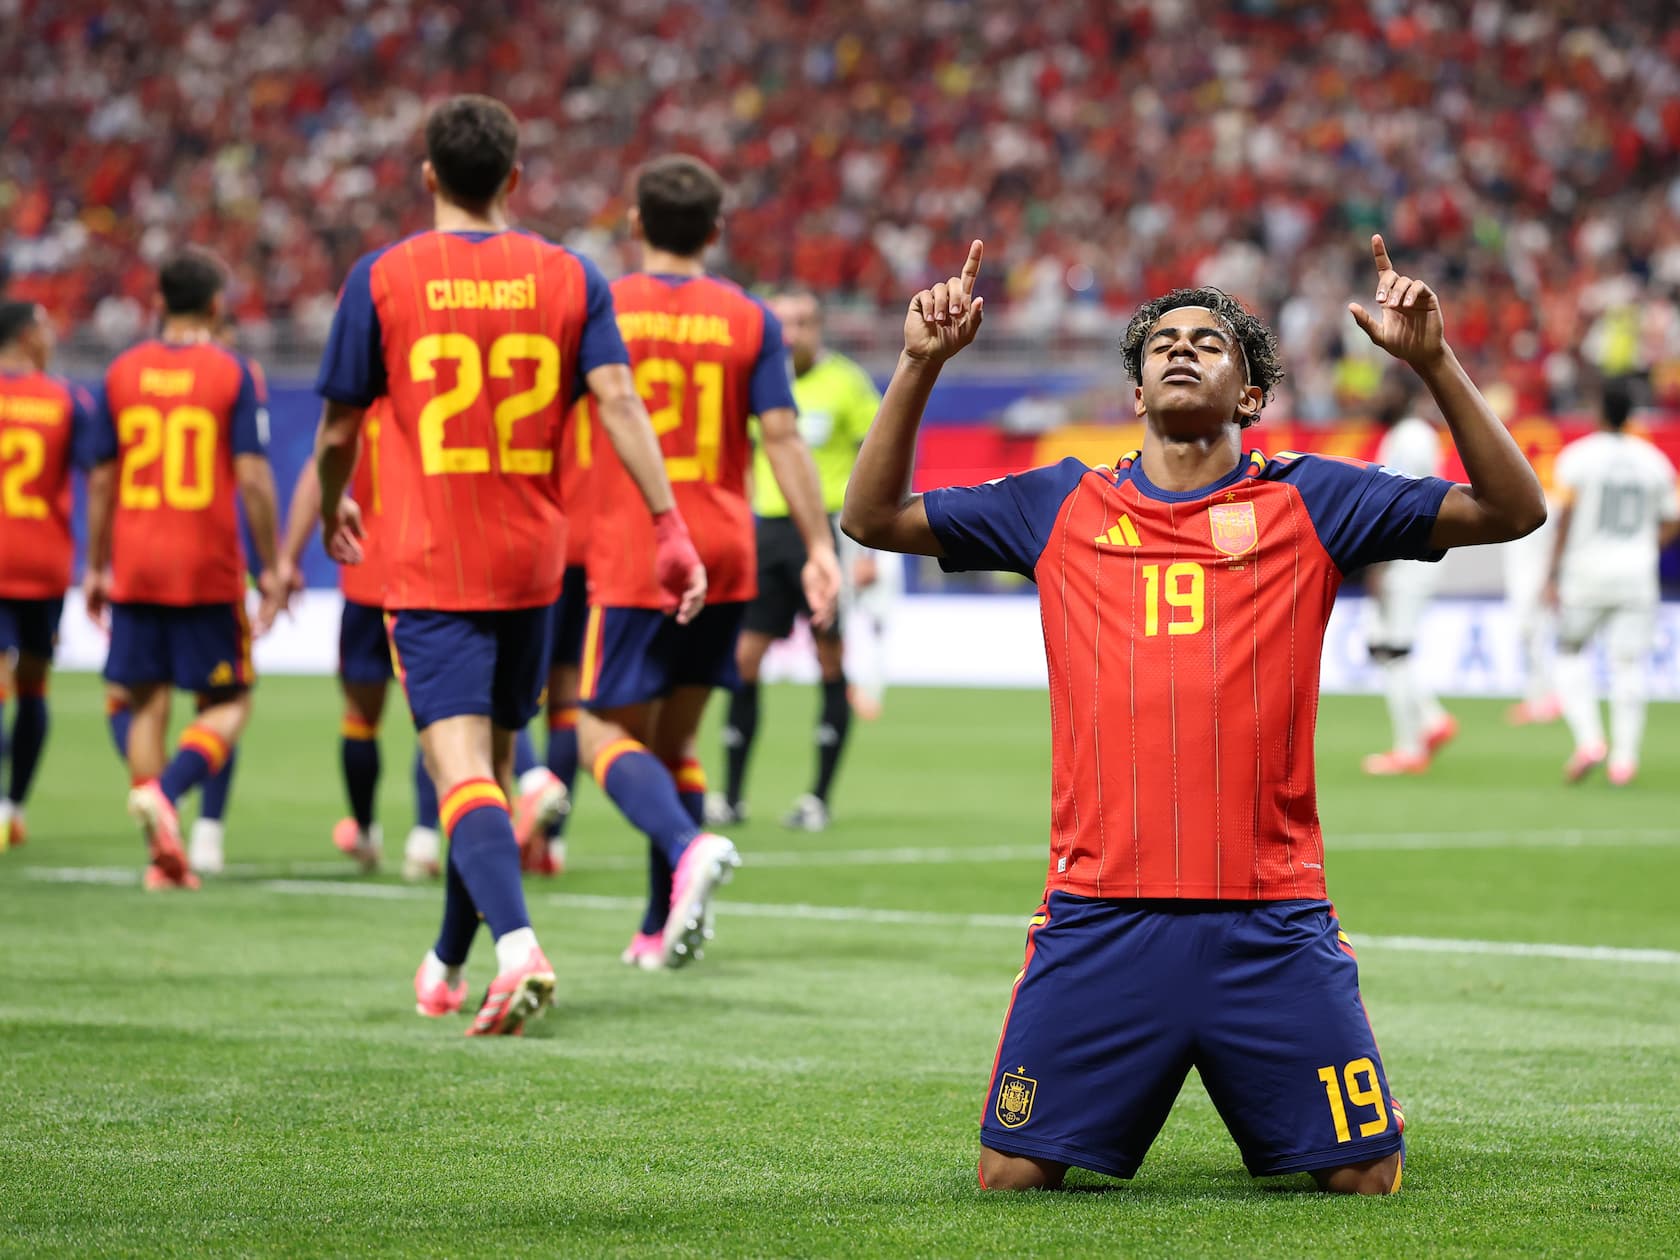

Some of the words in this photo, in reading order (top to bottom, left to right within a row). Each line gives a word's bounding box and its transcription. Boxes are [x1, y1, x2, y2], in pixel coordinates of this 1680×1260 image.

[426, 273, 536, 310] CUBARSÍ
[408, 333, 561, 475] 22
[634, 357, 723, 487] 21
[118, 405, 217, 510] 20
[1142, 561, 1205, 637] 19
[1317, 1057, 1388, 1143] 19
